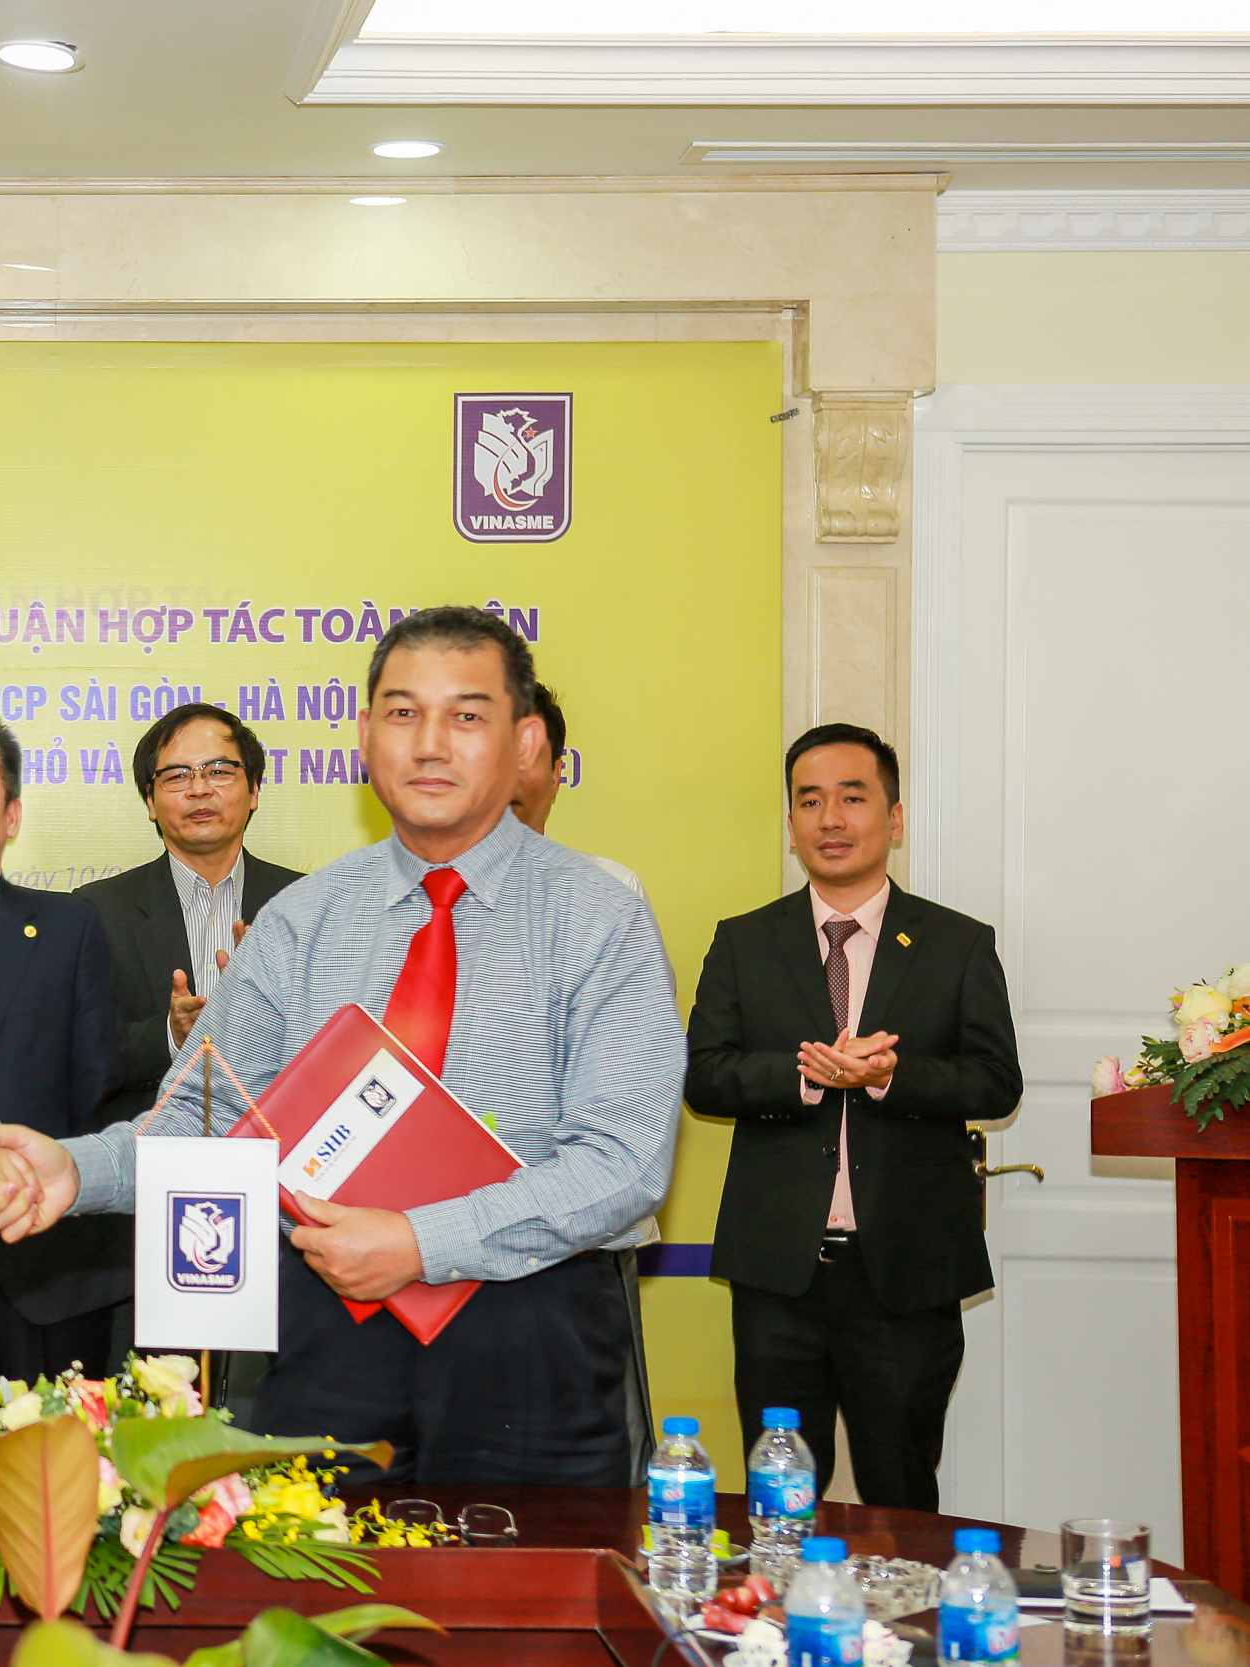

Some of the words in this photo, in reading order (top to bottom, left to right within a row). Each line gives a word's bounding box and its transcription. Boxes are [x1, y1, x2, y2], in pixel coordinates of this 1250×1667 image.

[470, 515, 554, 530] VINASME
[98, 605, 194, 654] HỢP
[203, 601, 286, 643] TÁC
[59, 677, 117, 721] SÀI
[239, 677, 285, 721] HÀ
[297, 677, 357, 729] NỘI
[23, 736, 67, 785] HỎ
[79, 741, 125, 785] VÀ
[316, 1124, 352, 1162] SHB
[177, 1272, 236, 1286] VINASME
